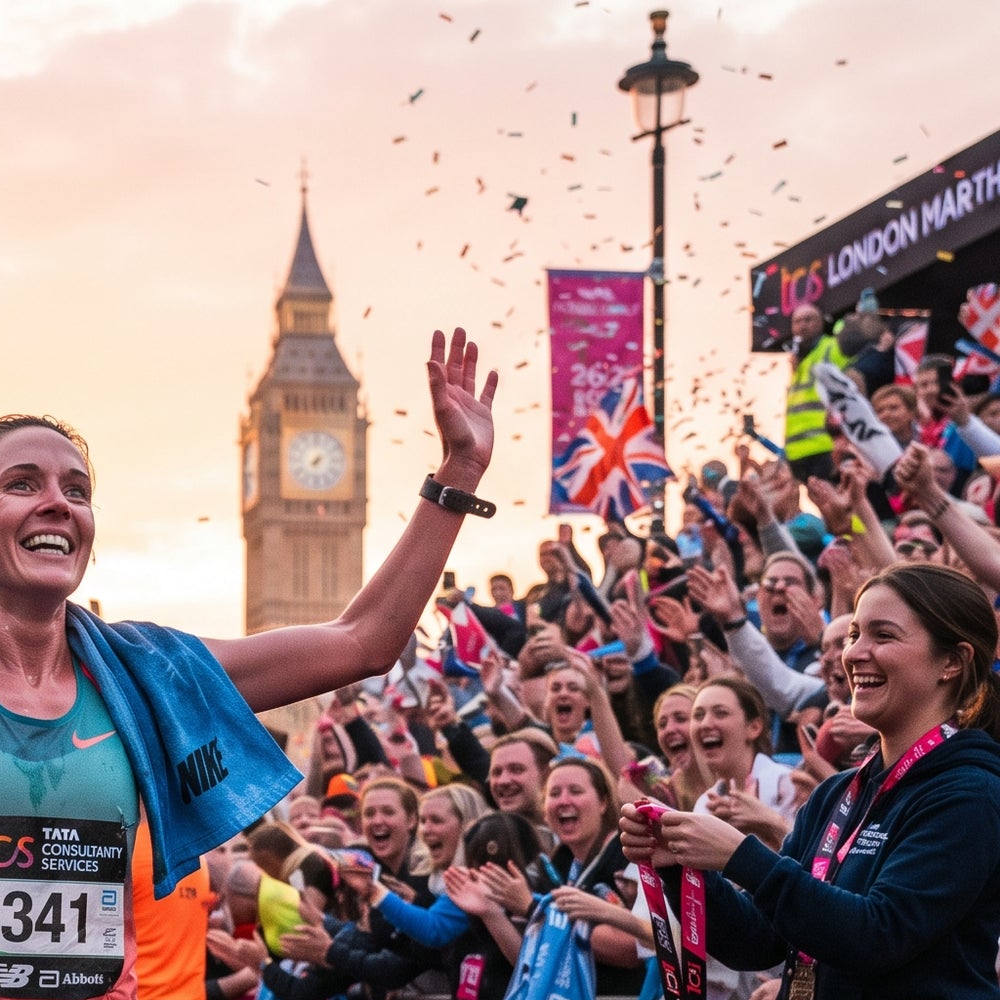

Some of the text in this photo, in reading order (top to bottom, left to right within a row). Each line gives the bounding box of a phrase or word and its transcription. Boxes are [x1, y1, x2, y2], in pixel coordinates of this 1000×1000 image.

[827, 208, 919, 288] LONDON
[177, 736, 230, 805] NIKE
[42, 827, 80, 842] TATA
[41, 857, 99, 873] SERVICES
[1, 891, 88, 944] 341
